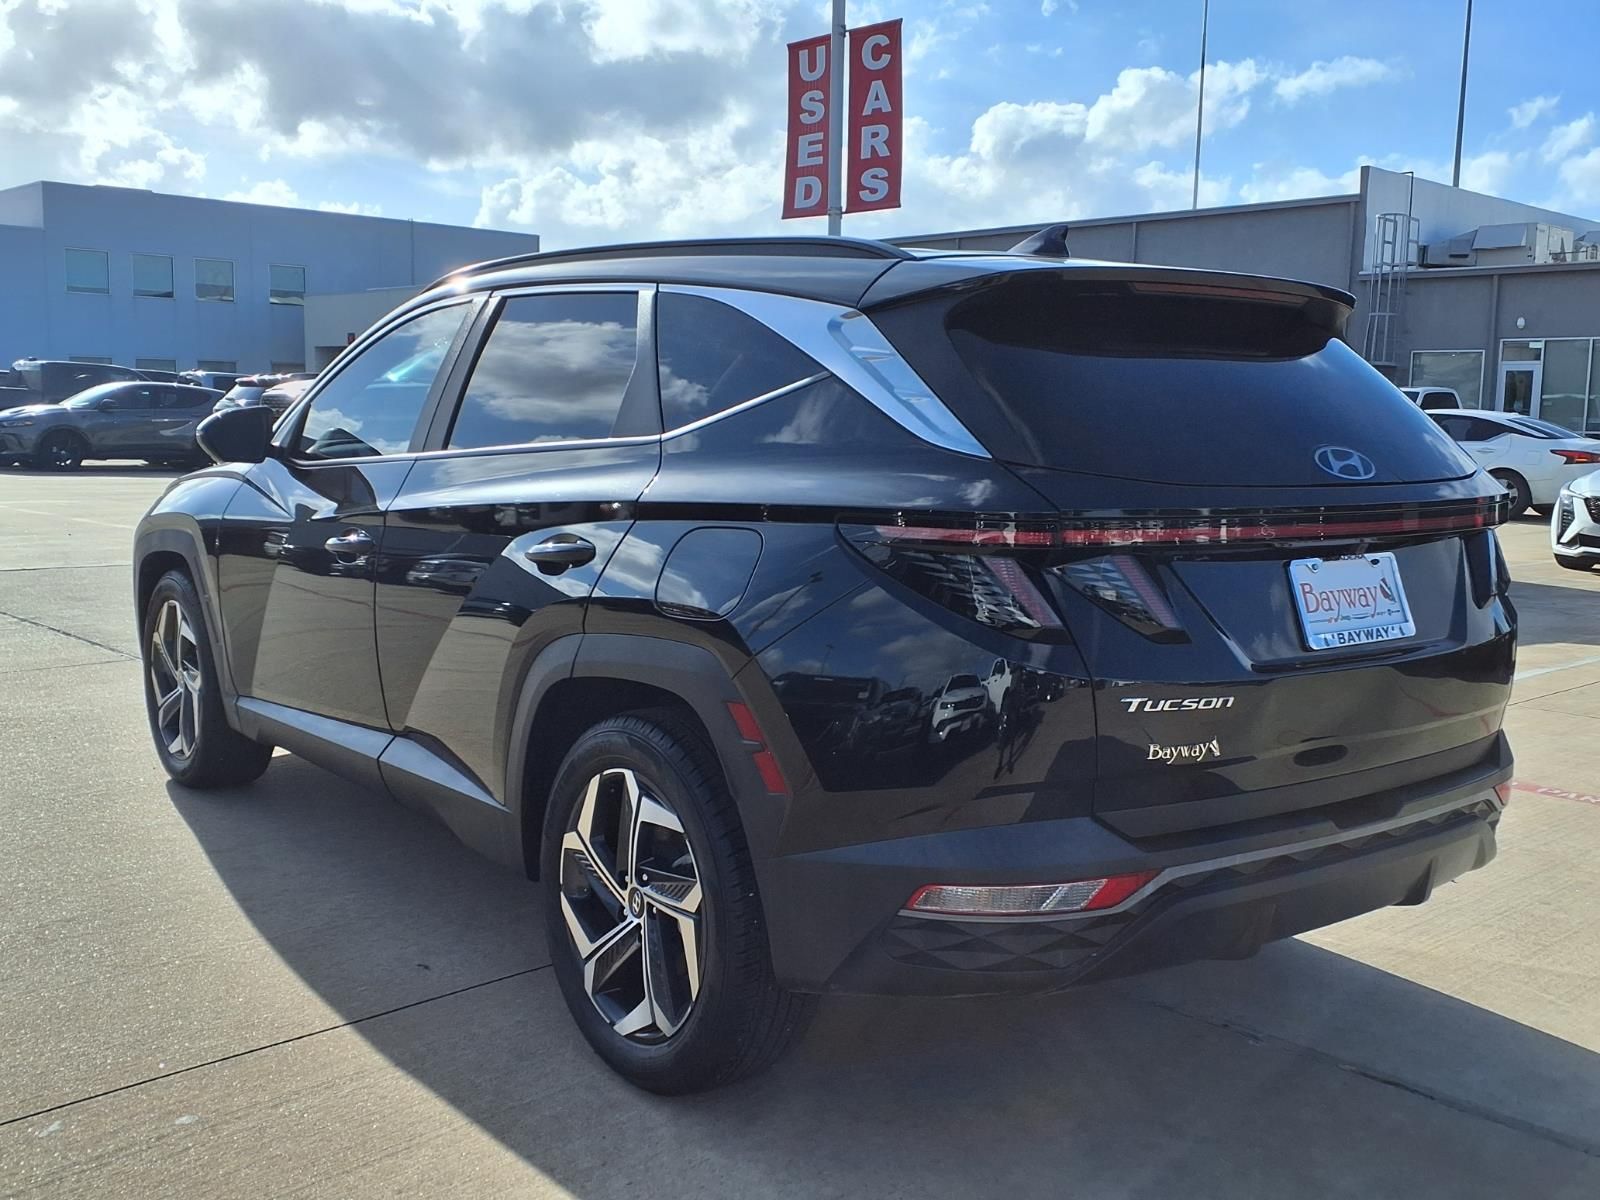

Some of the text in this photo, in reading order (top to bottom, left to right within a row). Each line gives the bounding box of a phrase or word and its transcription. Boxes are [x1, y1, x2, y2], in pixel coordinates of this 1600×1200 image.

[794, 45, 826, 209] USED
[859, 34, 892, 202] CARS
[1300, 582, 1378, 623] Bayway
[1337, 626, 1389, 645] BAYWAY
[1120, 696, 1235, 713] Tucson
[1146, 741, 1209, 765] Bayway
